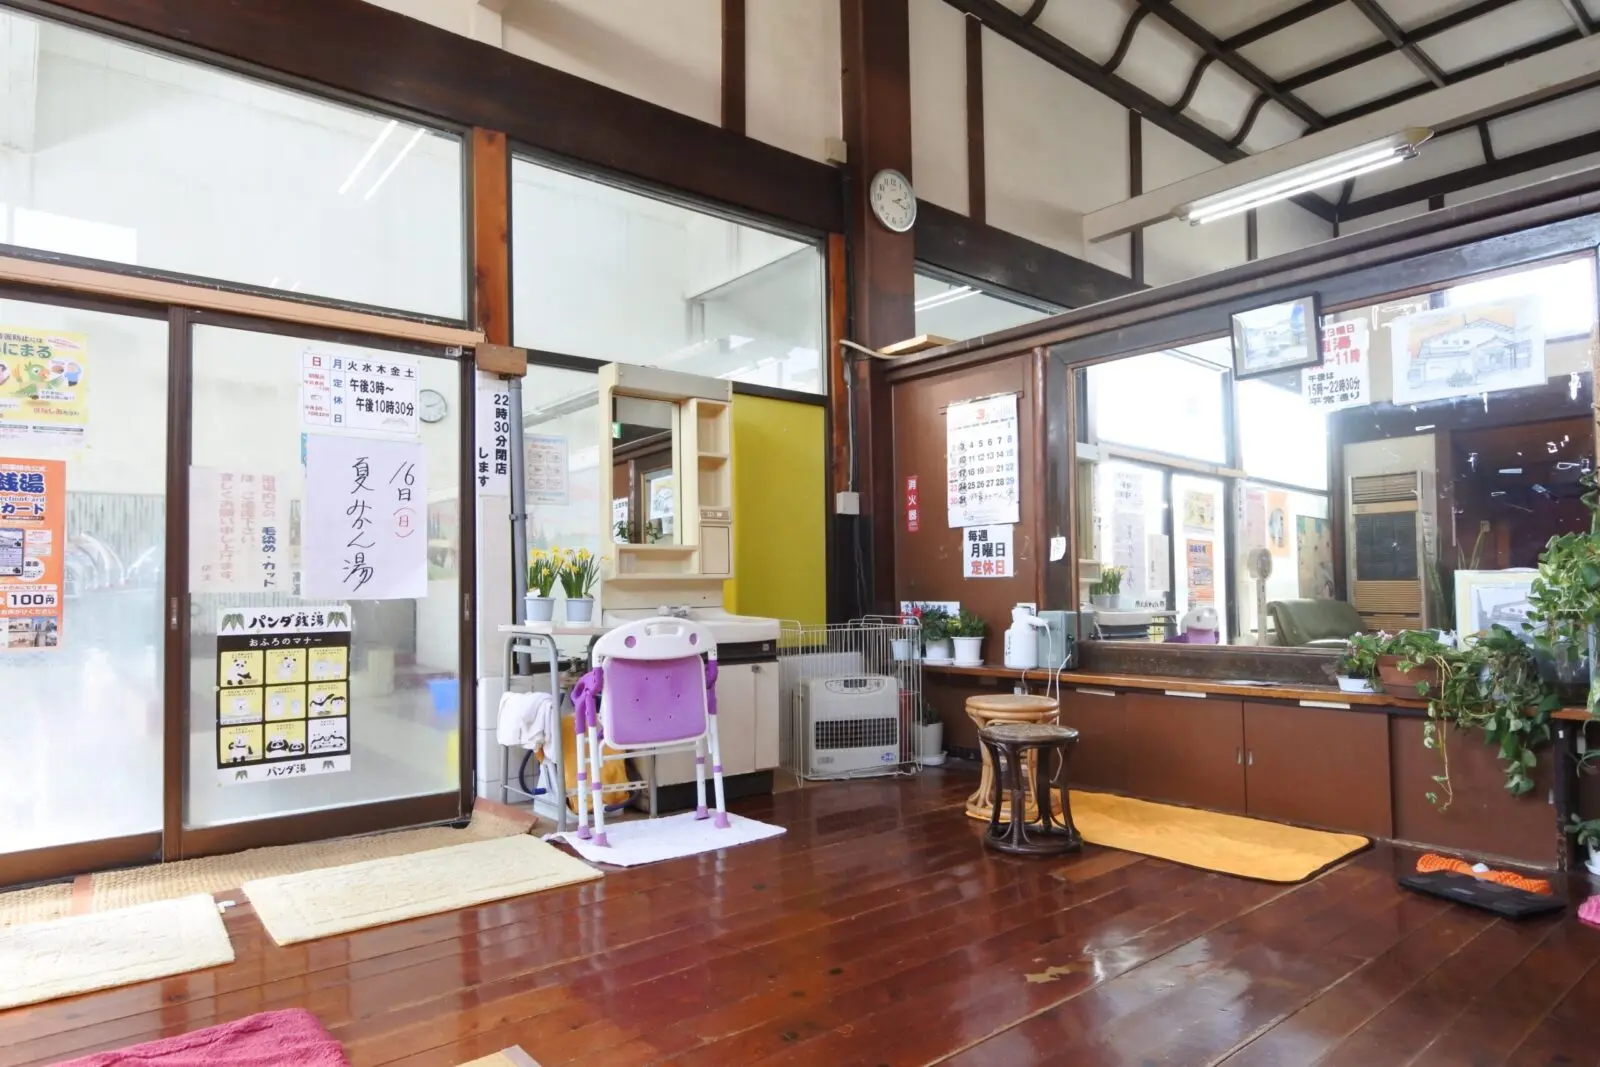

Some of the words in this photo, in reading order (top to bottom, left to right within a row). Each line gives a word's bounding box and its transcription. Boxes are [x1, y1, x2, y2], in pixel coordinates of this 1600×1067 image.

[0, 342, 51, 359] にまる
[312, 356, 322, 367] 日
[333, 359, 342, 369] 月
[356, 397, 414, 416] 午後10時30分
[494, 393, 509, 475] 22時30分閉店
[478, 446, 490, 487] します
[996, 478, 1004, 486] 28
[1, 503, 44, 515] カード
[342, 456, 375, 592] 夏みかん湯
[968, 529, 988, 541] 毎週
[971, 542, 1005, 558] 月曜日
[971, 559, 1005, 575] 定休日
[11, 594, 55, 605] 100円
[248, 612, 324, 628] パンダ銭湯
[249, 636, 322, 647] おふろのマナー
[267, 763, 307, 777] パンダ湯
